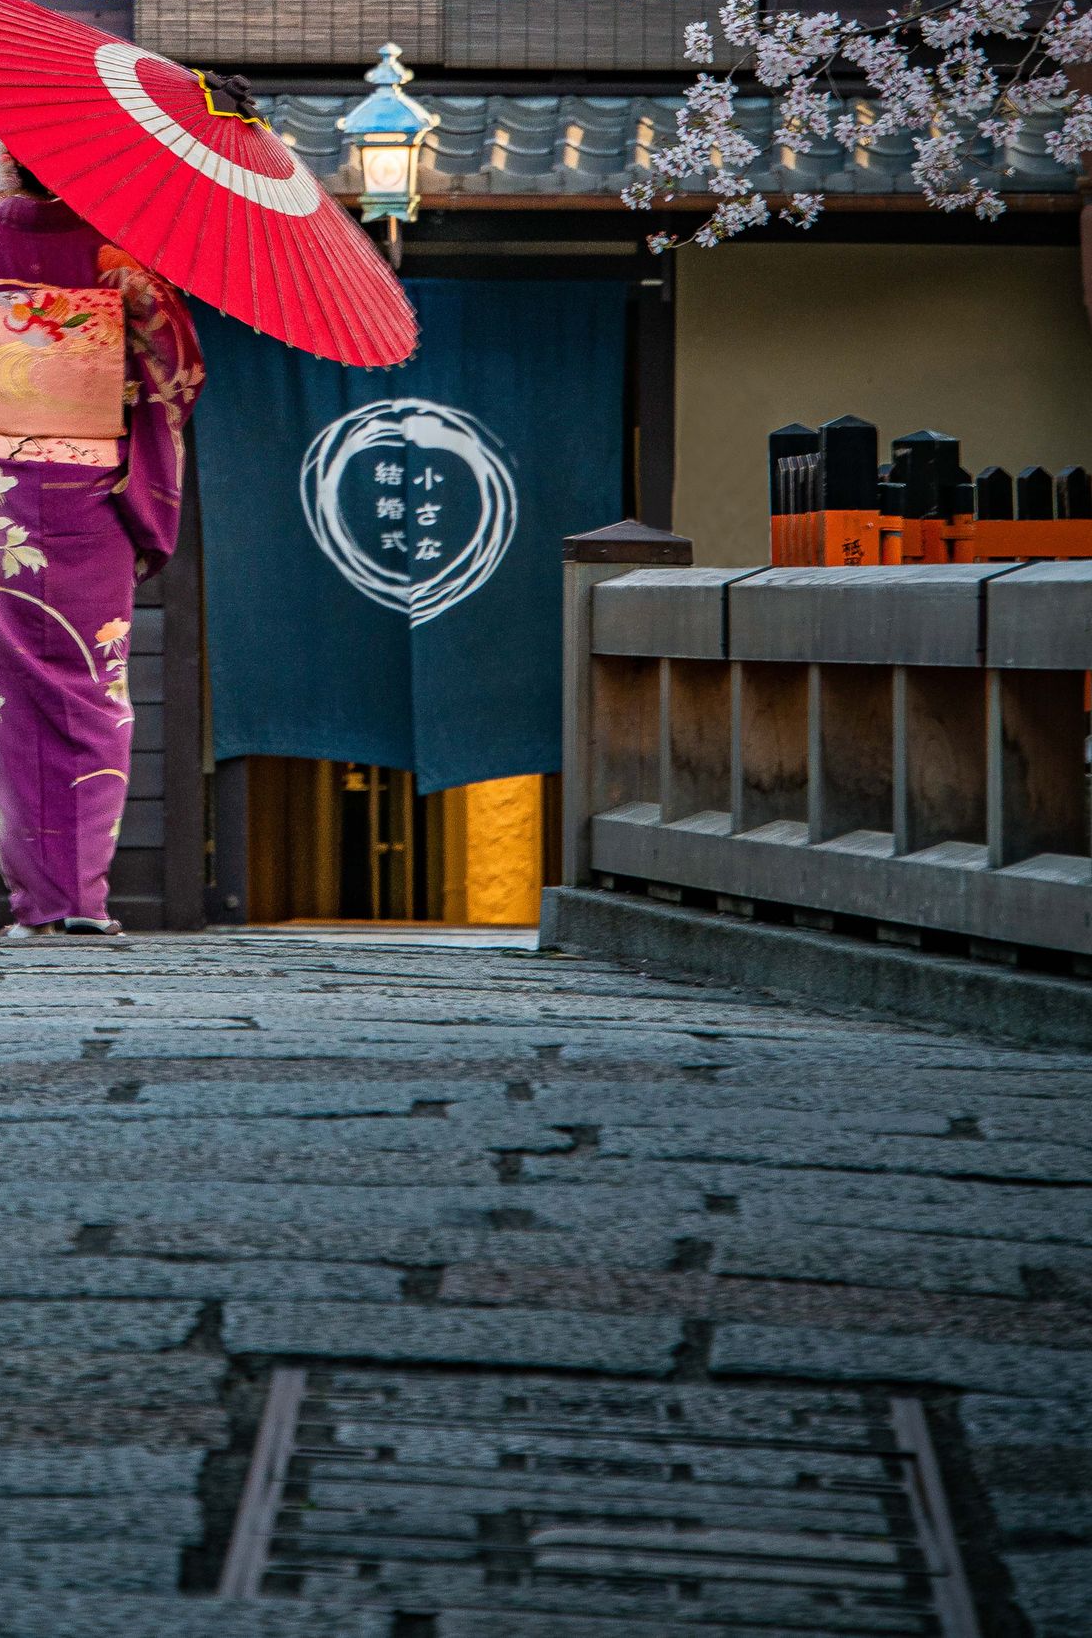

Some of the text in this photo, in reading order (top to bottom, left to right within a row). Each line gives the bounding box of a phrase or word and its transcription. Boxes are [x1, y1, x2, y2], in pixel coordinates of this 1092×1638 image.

[374, 460, 408, 554] 結婚式
[413, 466, 444, 562] 小さな
